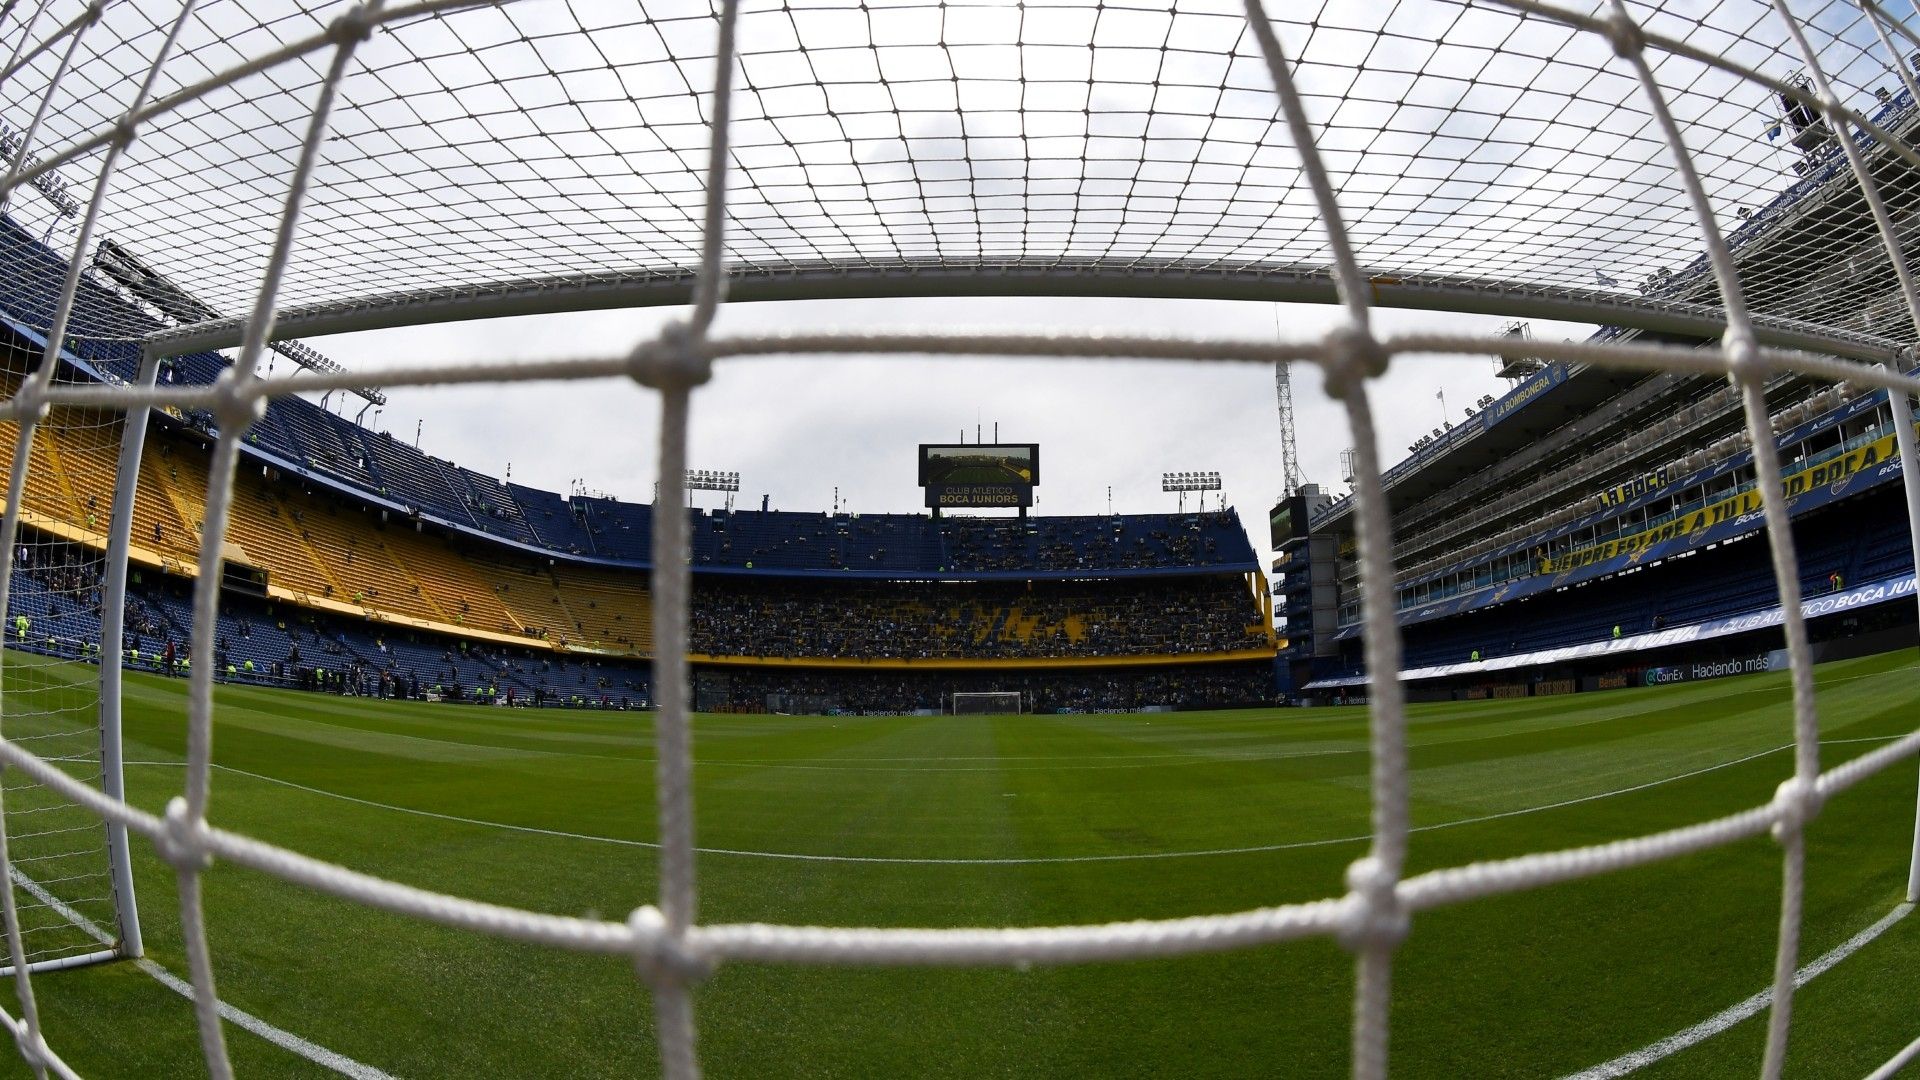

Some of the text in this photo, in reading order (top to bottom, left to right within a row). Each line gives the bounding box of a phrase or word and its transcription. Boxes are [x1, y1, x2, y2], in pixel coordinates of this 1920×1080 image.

[1505, 376, 1550, 411] BOMBONERA
[939, 495, 1019, 503] BOCA JUNIORS
[945, 486, 970, 495] CLUB
[1688, 511, 1705, 534] A
[1711, 500, 1737, 524] TU
[1811, 446, 1879, 490] BOCA
[1720, 615, 1760, 634] CLUB
[1761, 599, 1835, 627] ATLTICO
[1834, 587, 1885, 610] BOCA
[1656, 654, 1769, 683] CoinEx Haciendo más
[863, 708, 898, 717] Haciendo
[1093, 706, 1128, 715] Haciendo
